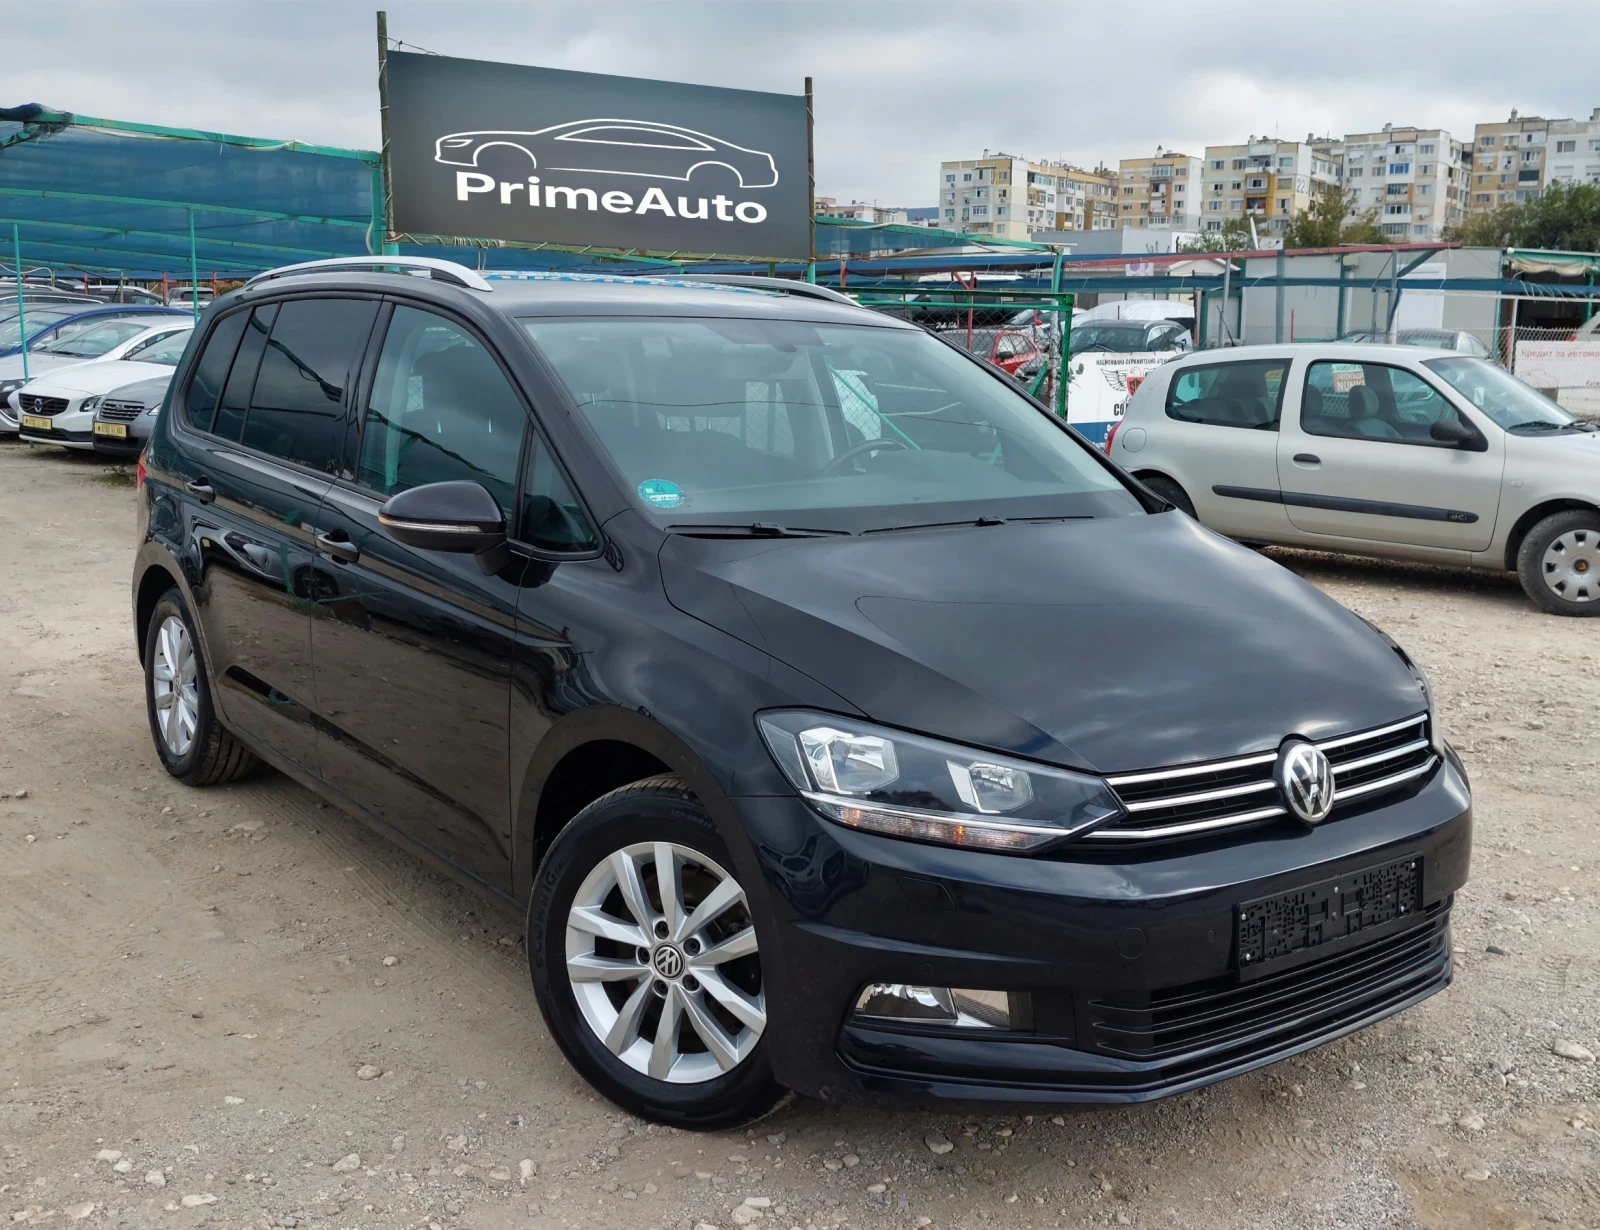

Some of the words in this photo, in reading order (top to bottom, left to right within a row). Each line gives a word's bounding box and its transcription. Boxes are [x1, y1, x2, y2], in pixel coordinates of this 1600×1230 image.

[456, 171, 768, 223] PrimeAuto
[1521, 349, 1553, 359] Кредит
[1555, 350, 1566, 358] за
